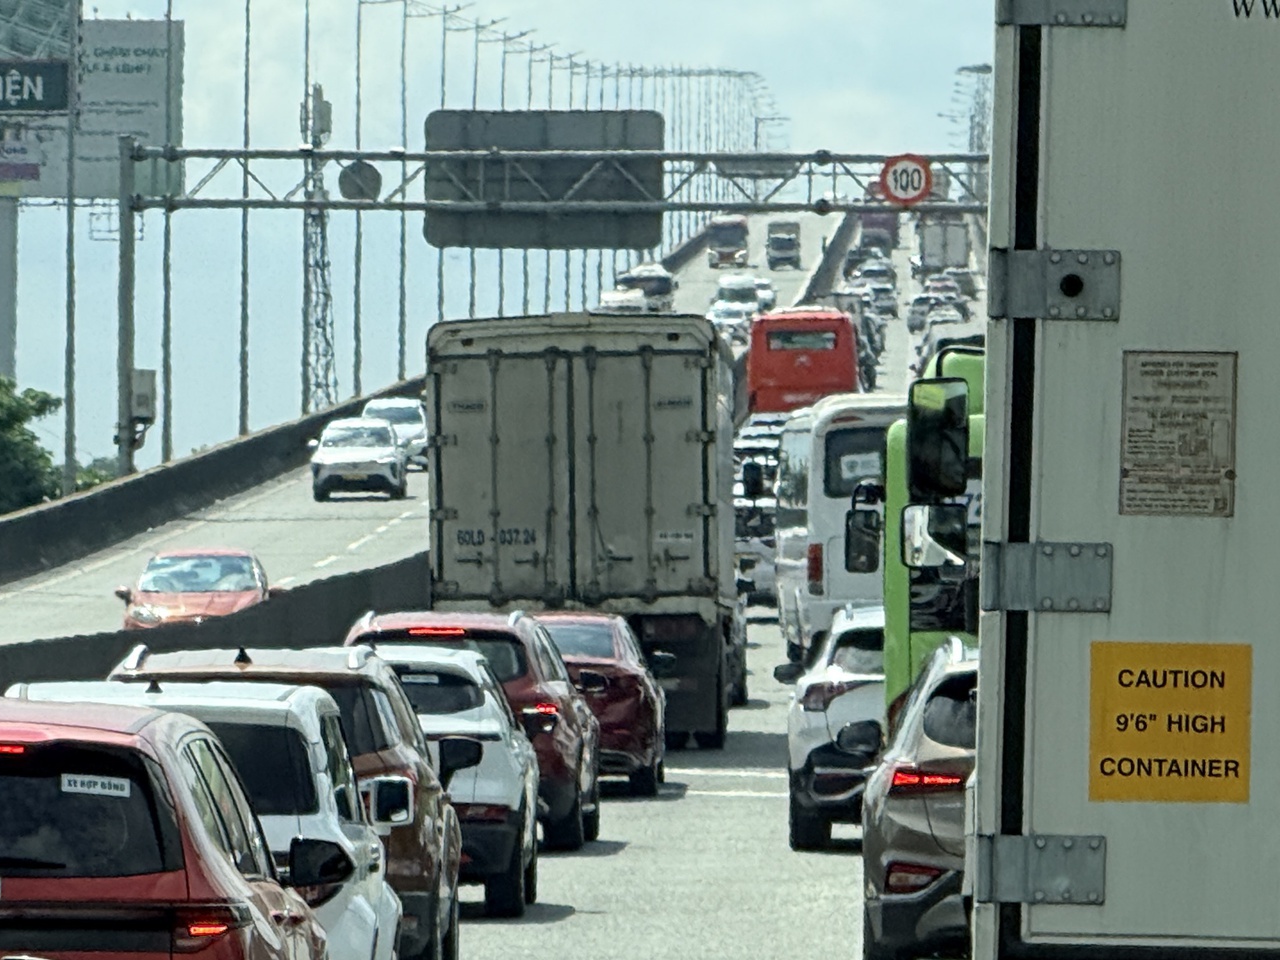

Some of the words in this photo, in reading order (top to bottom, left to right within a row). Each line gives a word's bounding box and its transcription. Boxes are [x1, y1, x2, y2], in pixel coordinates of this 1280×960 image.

[892, 168, 922, 192] 100
[1118, 669, 1225, 688] CAUTION
[1116, 713, 1157, 732] 9'6"
[1167, 714, 1226, 733] HIGH
[1099, 757, 1240, 778] CONTAINER
